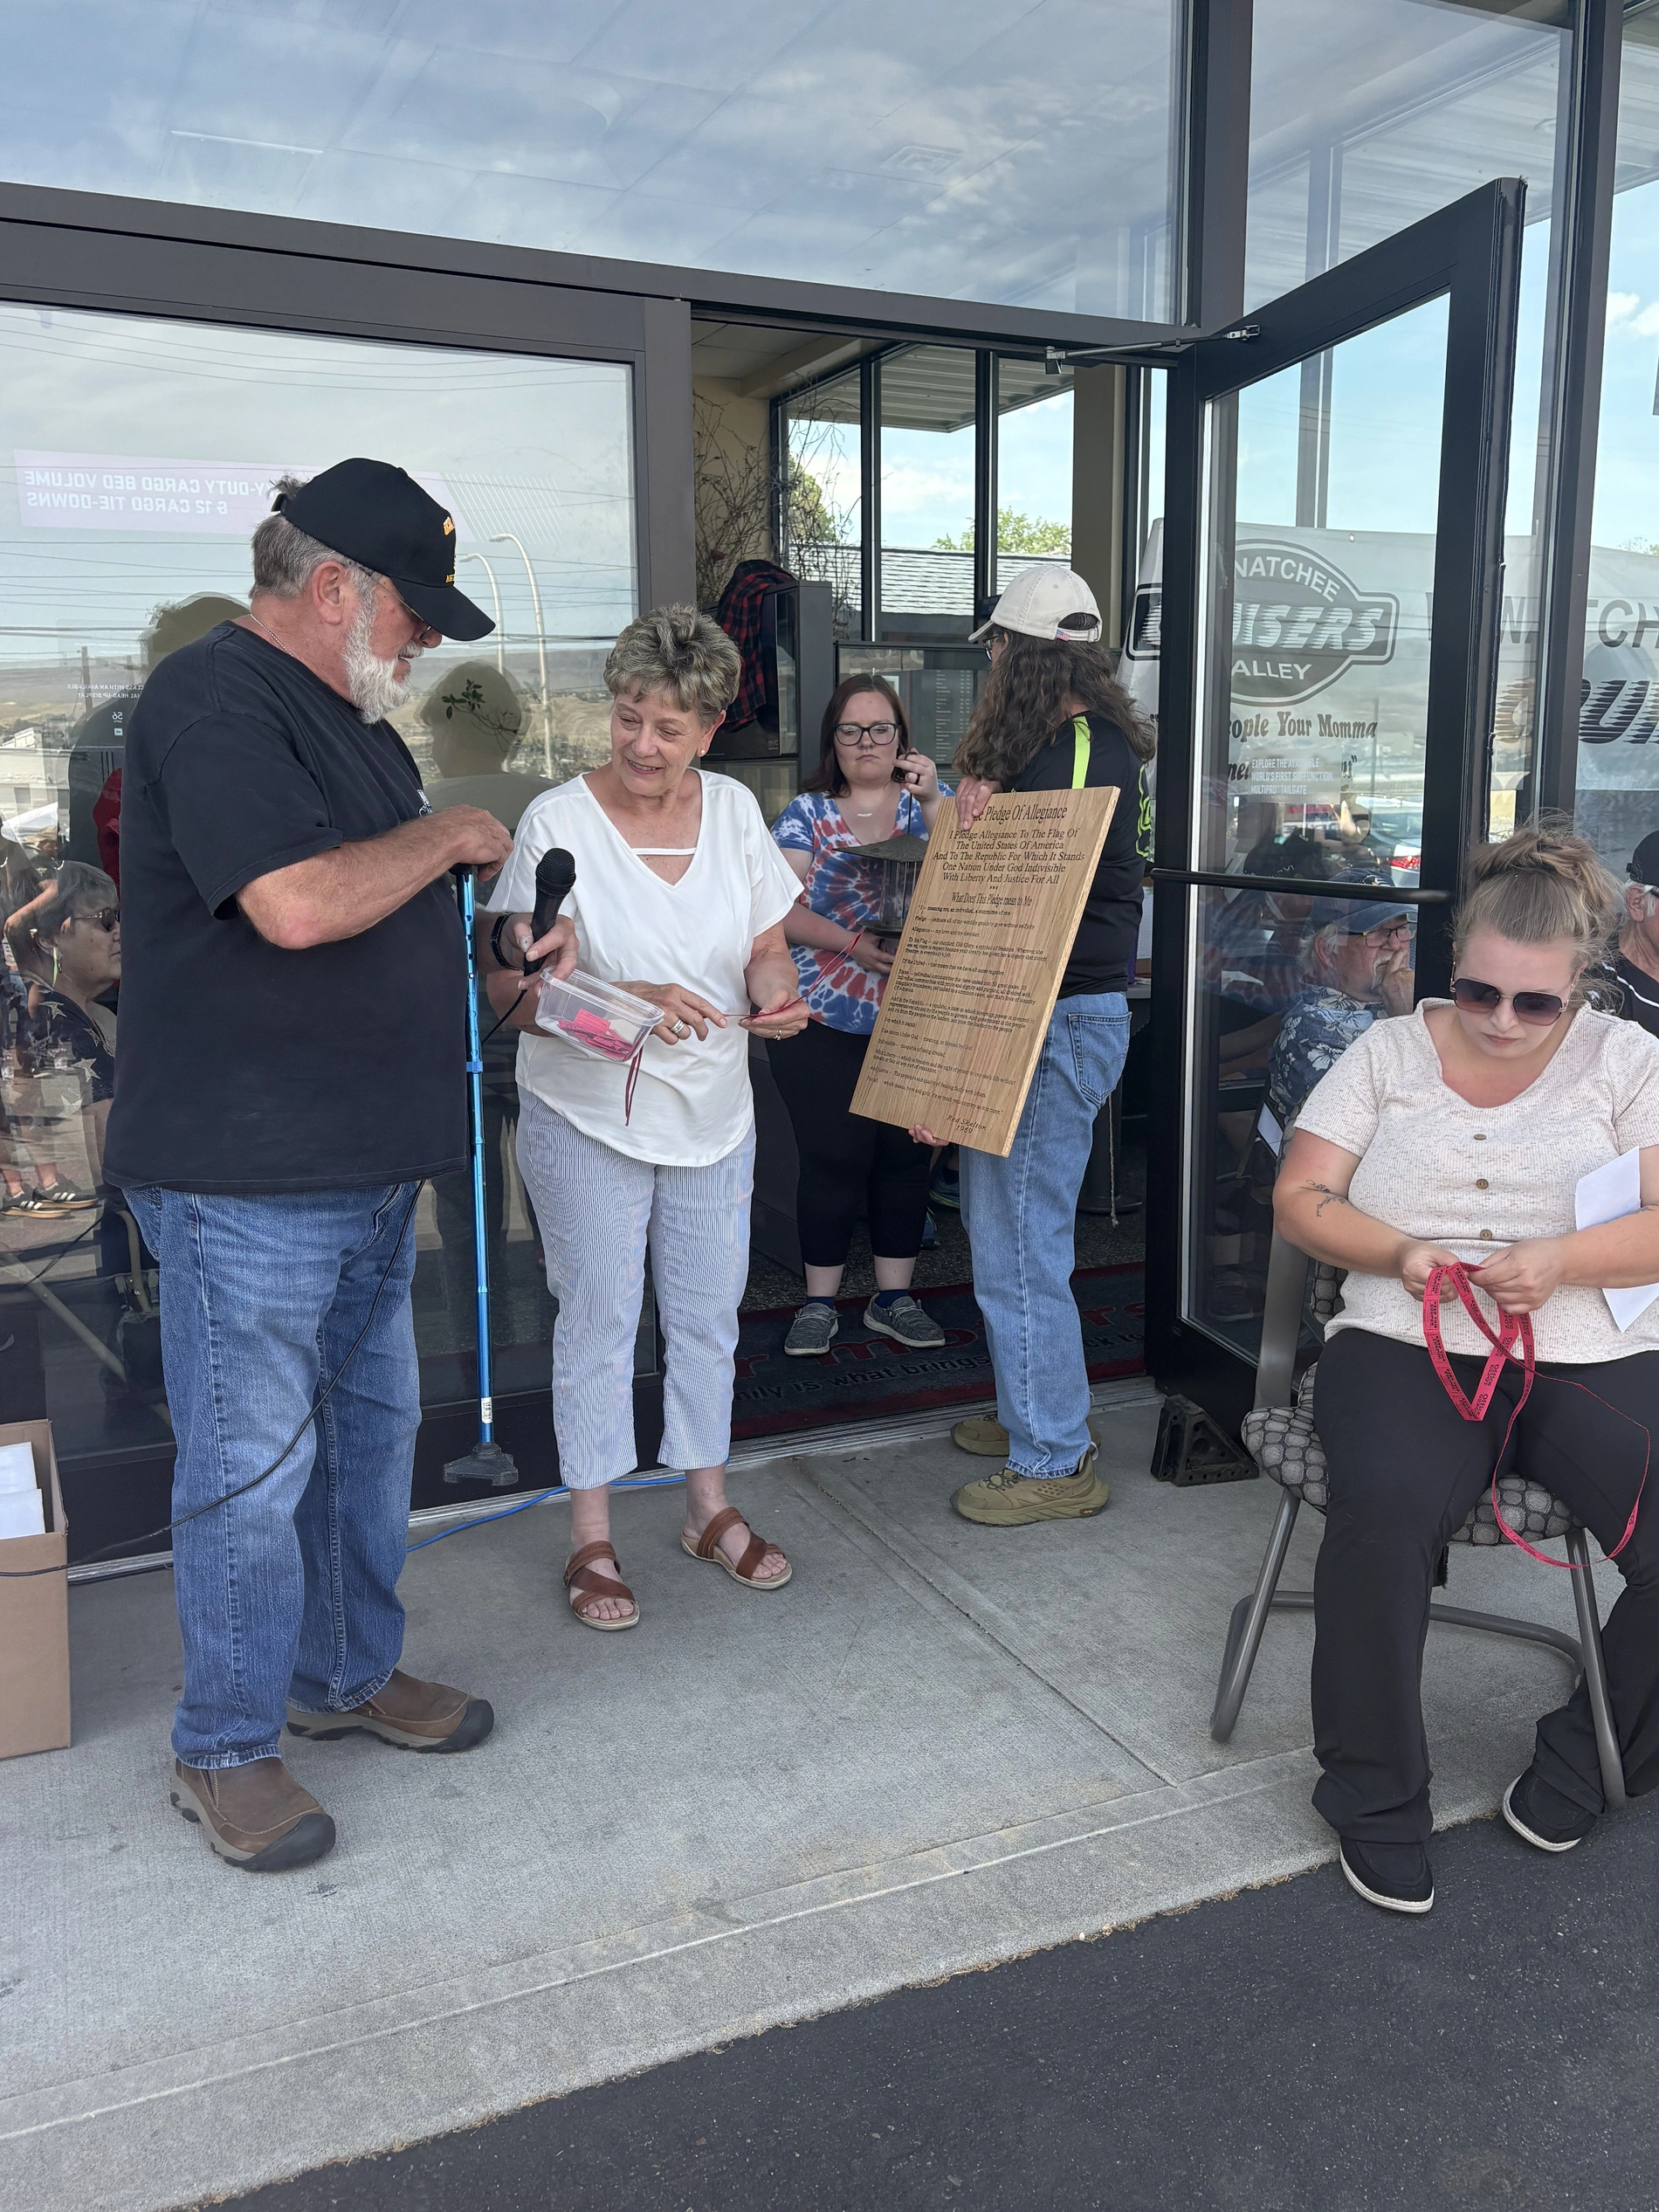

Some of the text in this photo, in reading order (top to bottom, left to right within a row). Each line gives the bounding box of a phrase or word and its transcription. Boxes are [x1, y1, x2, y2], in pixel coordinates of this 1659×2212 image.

[1235, 555, 1340, 603] NATCHEE
[1231, 659, 1312, 680] ALLEY
[1229, 711, 1378, 742] ople Your Momma
[1251, 759, 1276, 768] EXPLORE
[1277, 759, 1287, 768] THE
[1275, 771, 1291, 782] FIRST
[1280, 785, 1307, 795] TAILGATE
[983, 805, 1010, 825] Pledge
[1012, 804, 1025, 820] Of
[1024, 805, 1068, 824] Allegiance
[949, 828, 1080, 840] I Pledge Allegiance To The Flag Of
[956, 840, 1064, 850] The United States Of America
[933, 851, 1085, 862] And To The Republic For Which It Stands
[942, 862, 1066, 872] One Nation Under God Indivisible
[942, 872, 1060, 885] With Liberty And Justice For All
[951, 892, 963, 903] What
[964, 892, 976, 904] Does
[976, 892, 987, 904] This
[987, 892, 1004, 907] Pledge
[1022, 895, 1033, 906] Me
[947, 1114, 987, 1131] Red Skelton
[955, 1124, 974, 1134] 1969
[790, 1379, 823, 1393] is
[827, 1364, 898, 1388] what
[901, 1354, 991, 1377] brings
